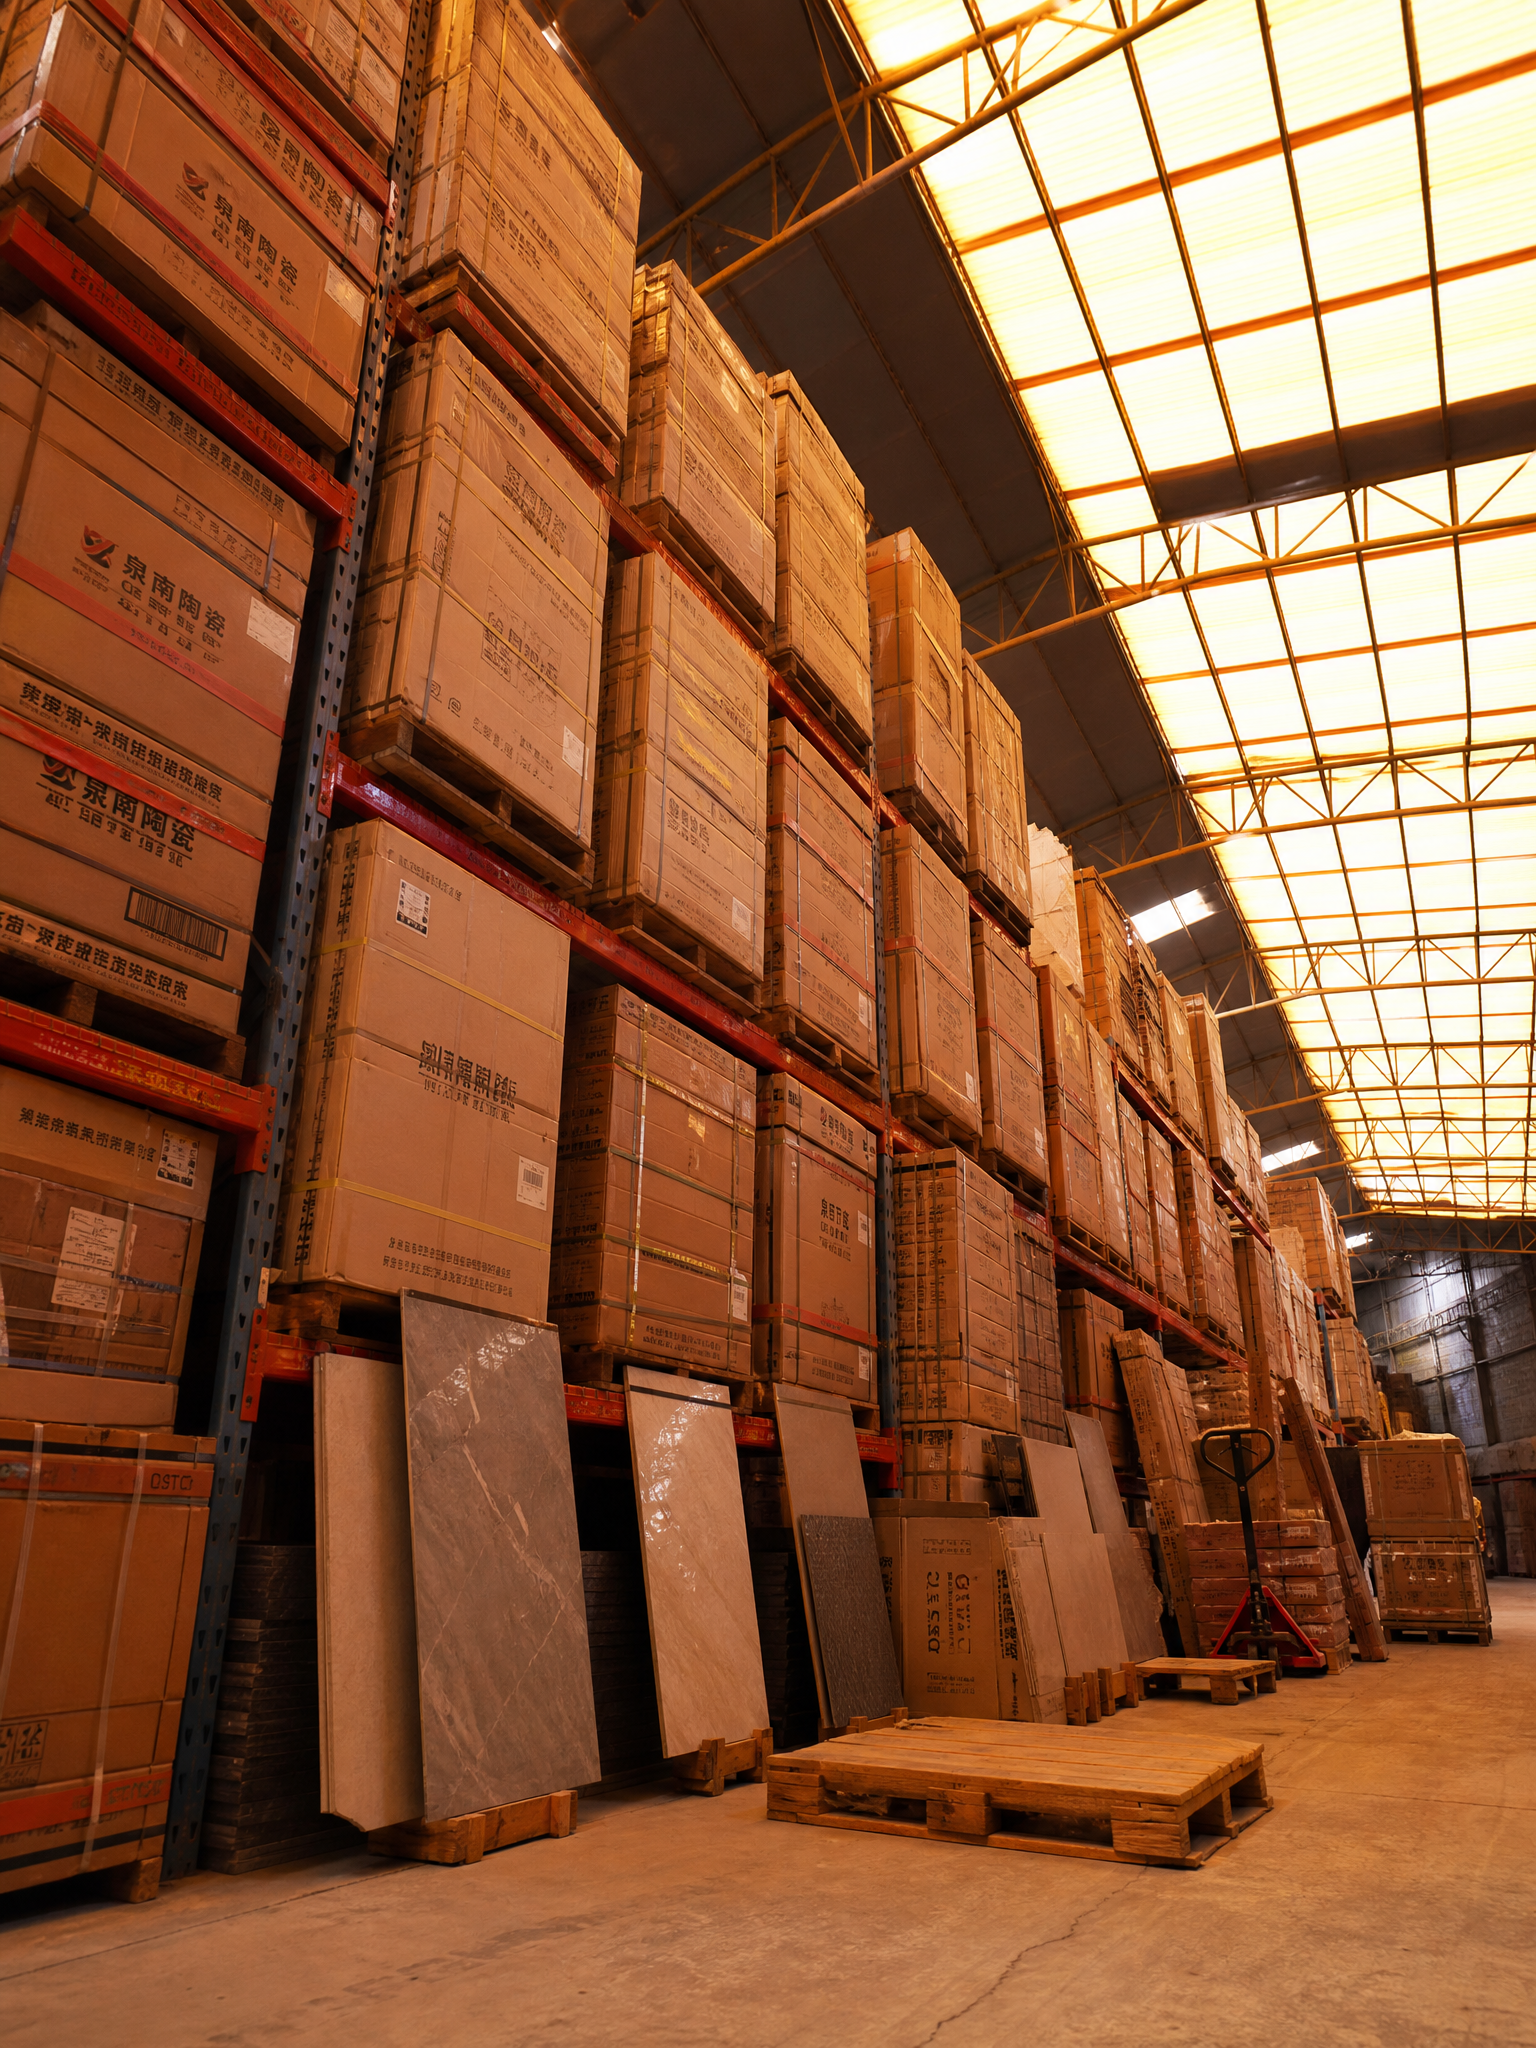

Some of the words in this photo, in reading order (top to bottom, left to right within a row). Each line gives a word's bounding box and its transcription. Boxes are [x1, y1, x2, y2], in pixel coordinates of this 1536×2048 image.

[213, 192, 299, 288] 泉南陶瓷
[123, 553, 226, 637] 泉南陶瓷
[82, 781, 195, 852] 泉南陶瓷
